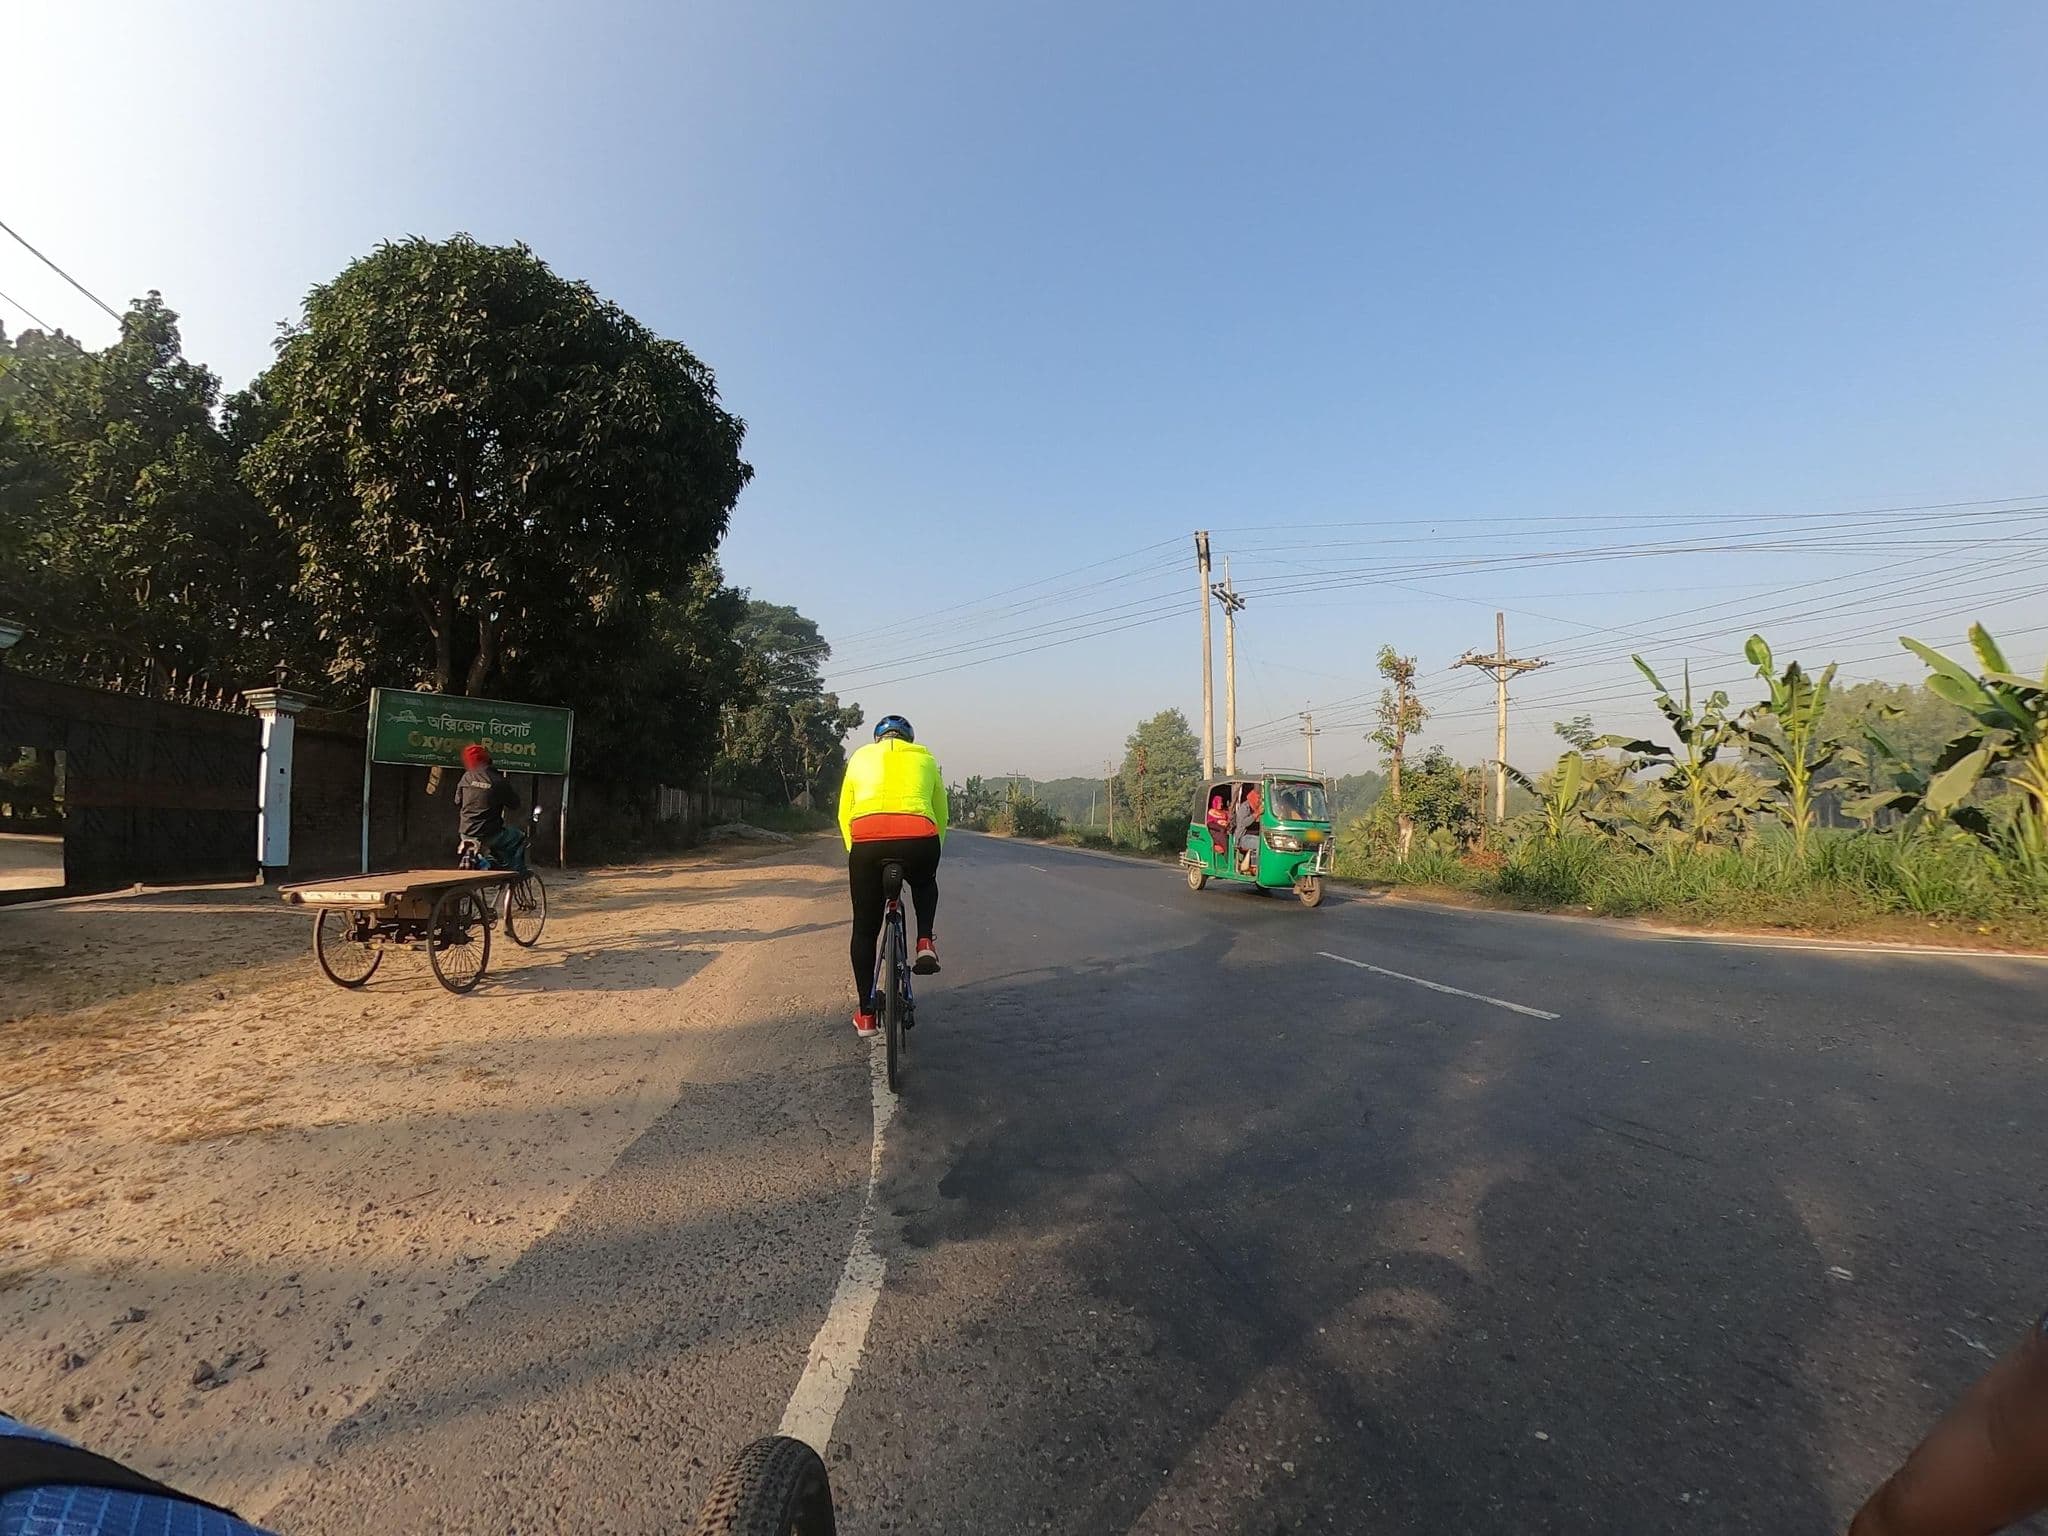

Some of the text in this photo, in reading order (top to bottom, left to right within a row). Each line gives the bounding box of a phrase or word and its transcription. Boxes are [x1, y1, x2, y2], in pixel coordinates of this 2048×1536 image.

[427, 713, 532, 738] অক্সিজেন রিসোর্ট
[408, 730, 537, 756] Oxyg Resort
